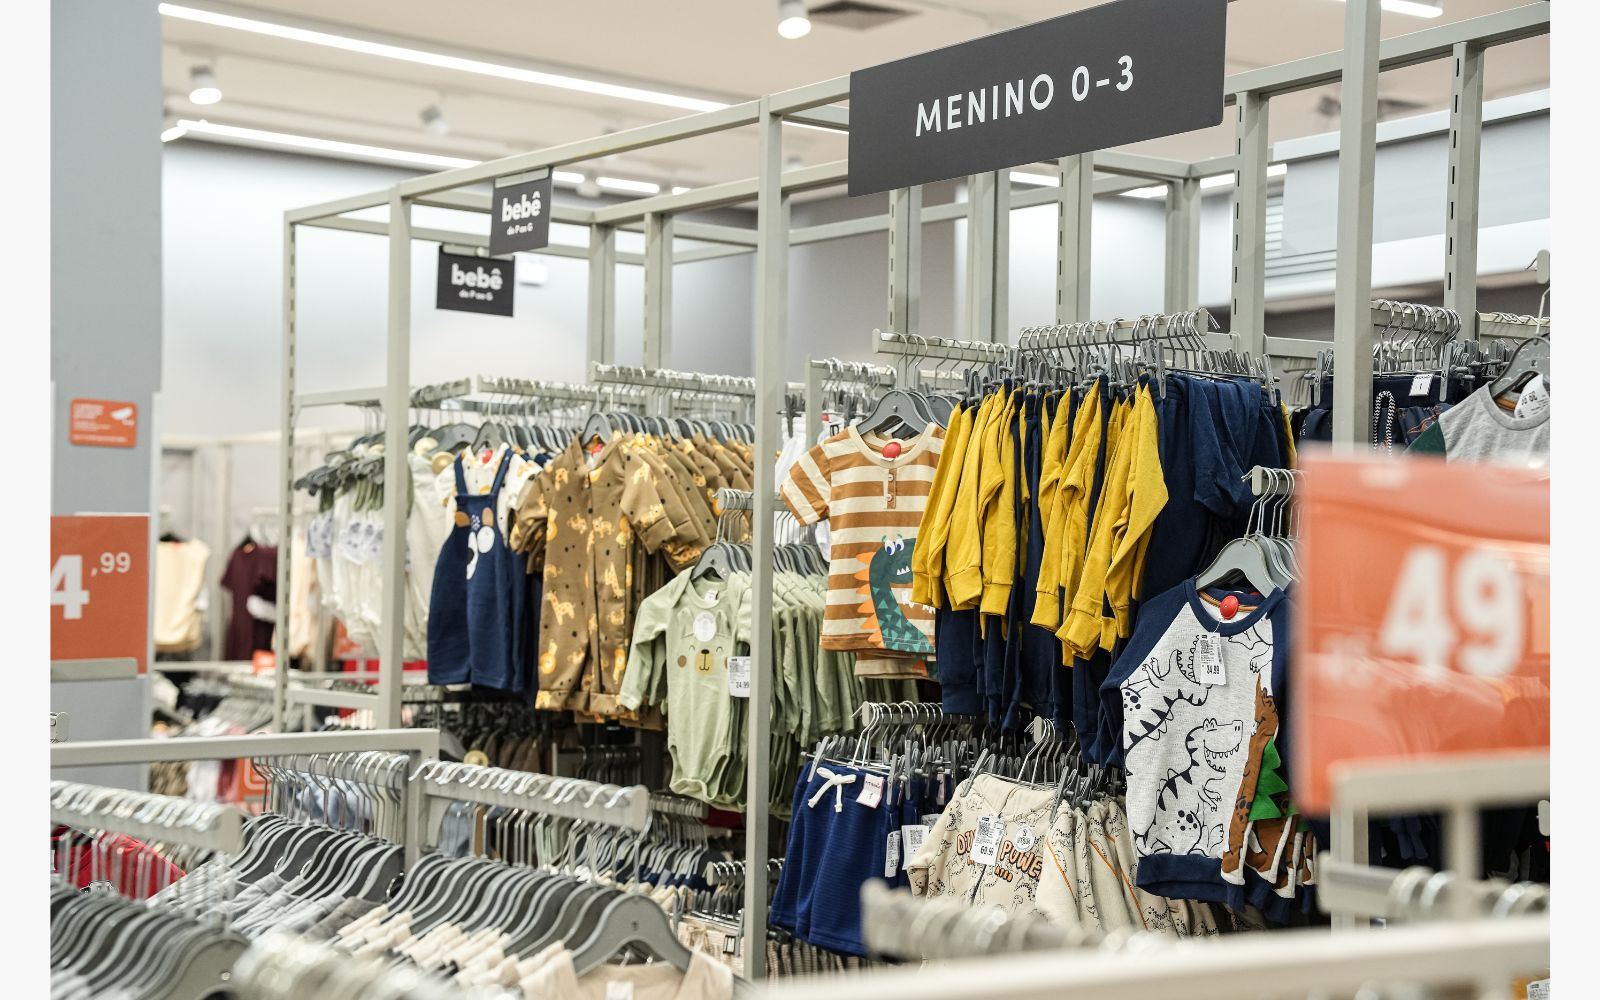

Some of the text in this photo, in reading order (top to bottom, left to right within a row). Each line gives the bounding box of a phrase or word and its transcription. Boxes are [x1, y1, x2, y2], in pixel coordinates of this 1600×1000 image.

[915, 55, 1134, 137] MENINO 0-3
[502, 191, 541, 222] bebê
[451, 263, 503, 290] bebê
[1382, 545, 1524, 681] 49
[1000, 840, 1042, 883] POWE
